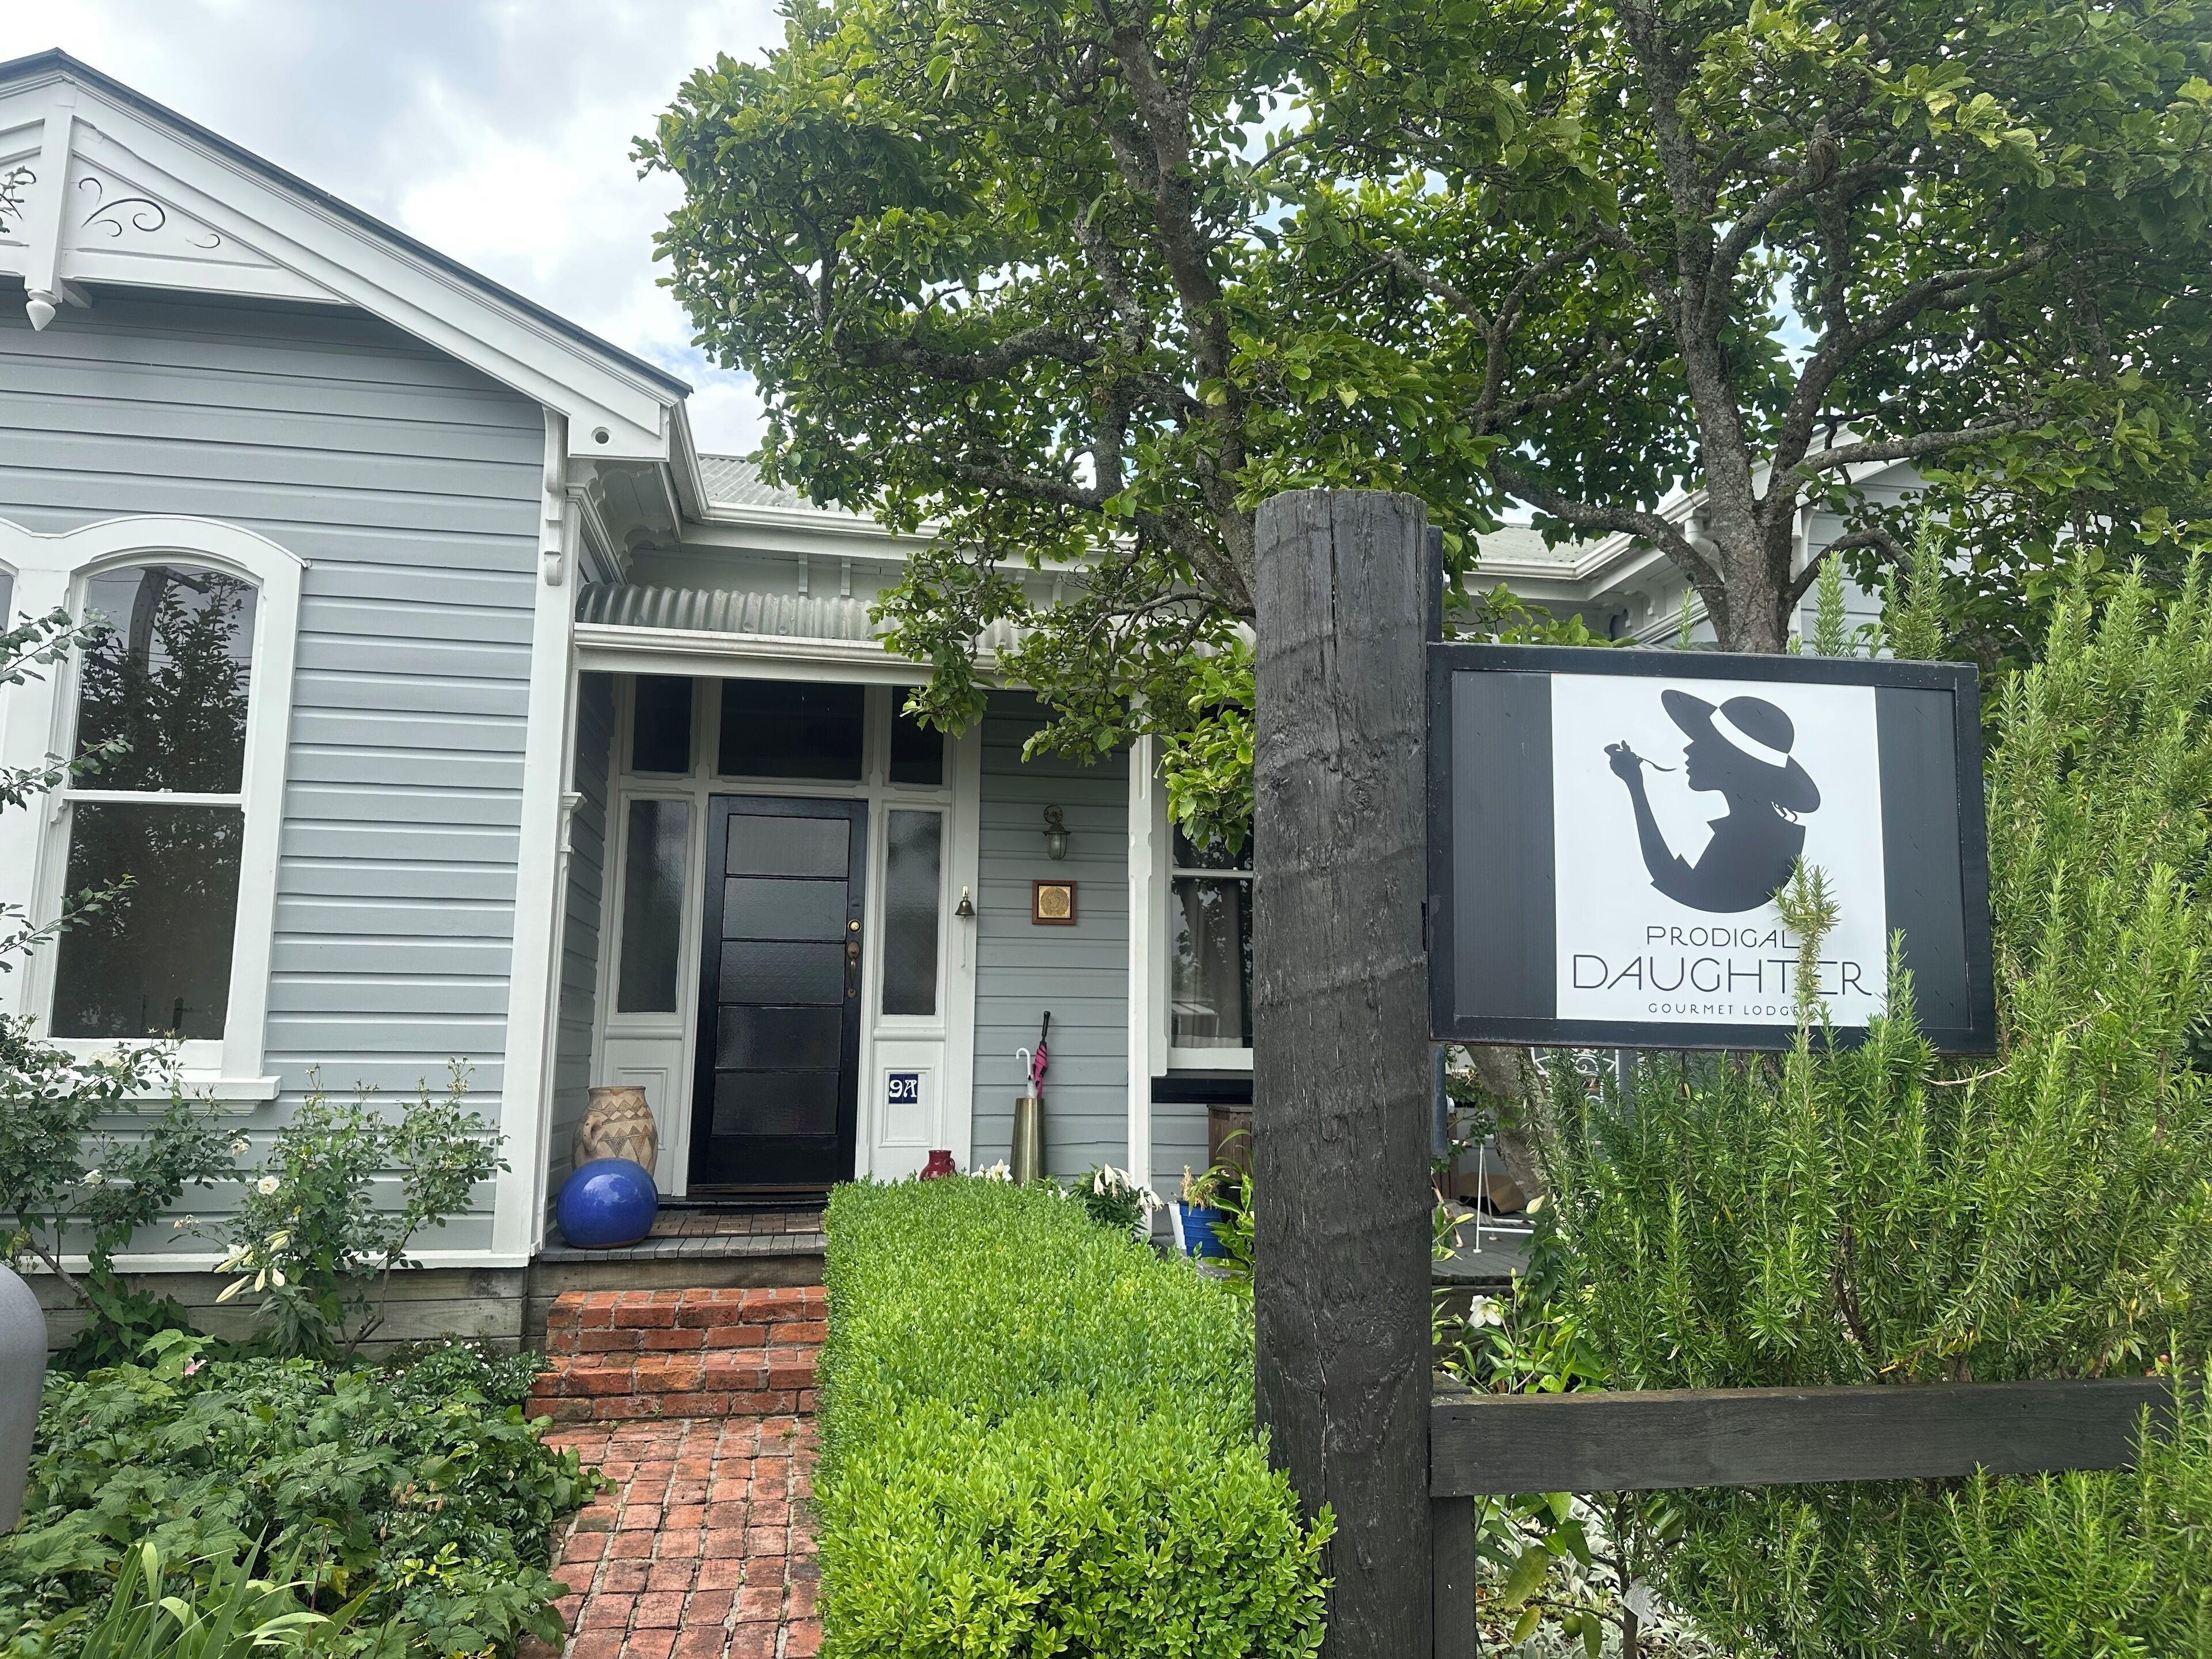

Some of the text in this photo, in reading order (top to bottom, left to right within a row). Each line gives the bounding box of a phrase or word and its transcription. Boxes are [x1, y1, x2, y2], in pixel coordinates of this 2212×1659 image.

[1646, 926, 1801, 949] PRODIGAL
[1648, 1003, 1733, 1015] GOURMET
[889, 1079, 917, 1098] 9A
